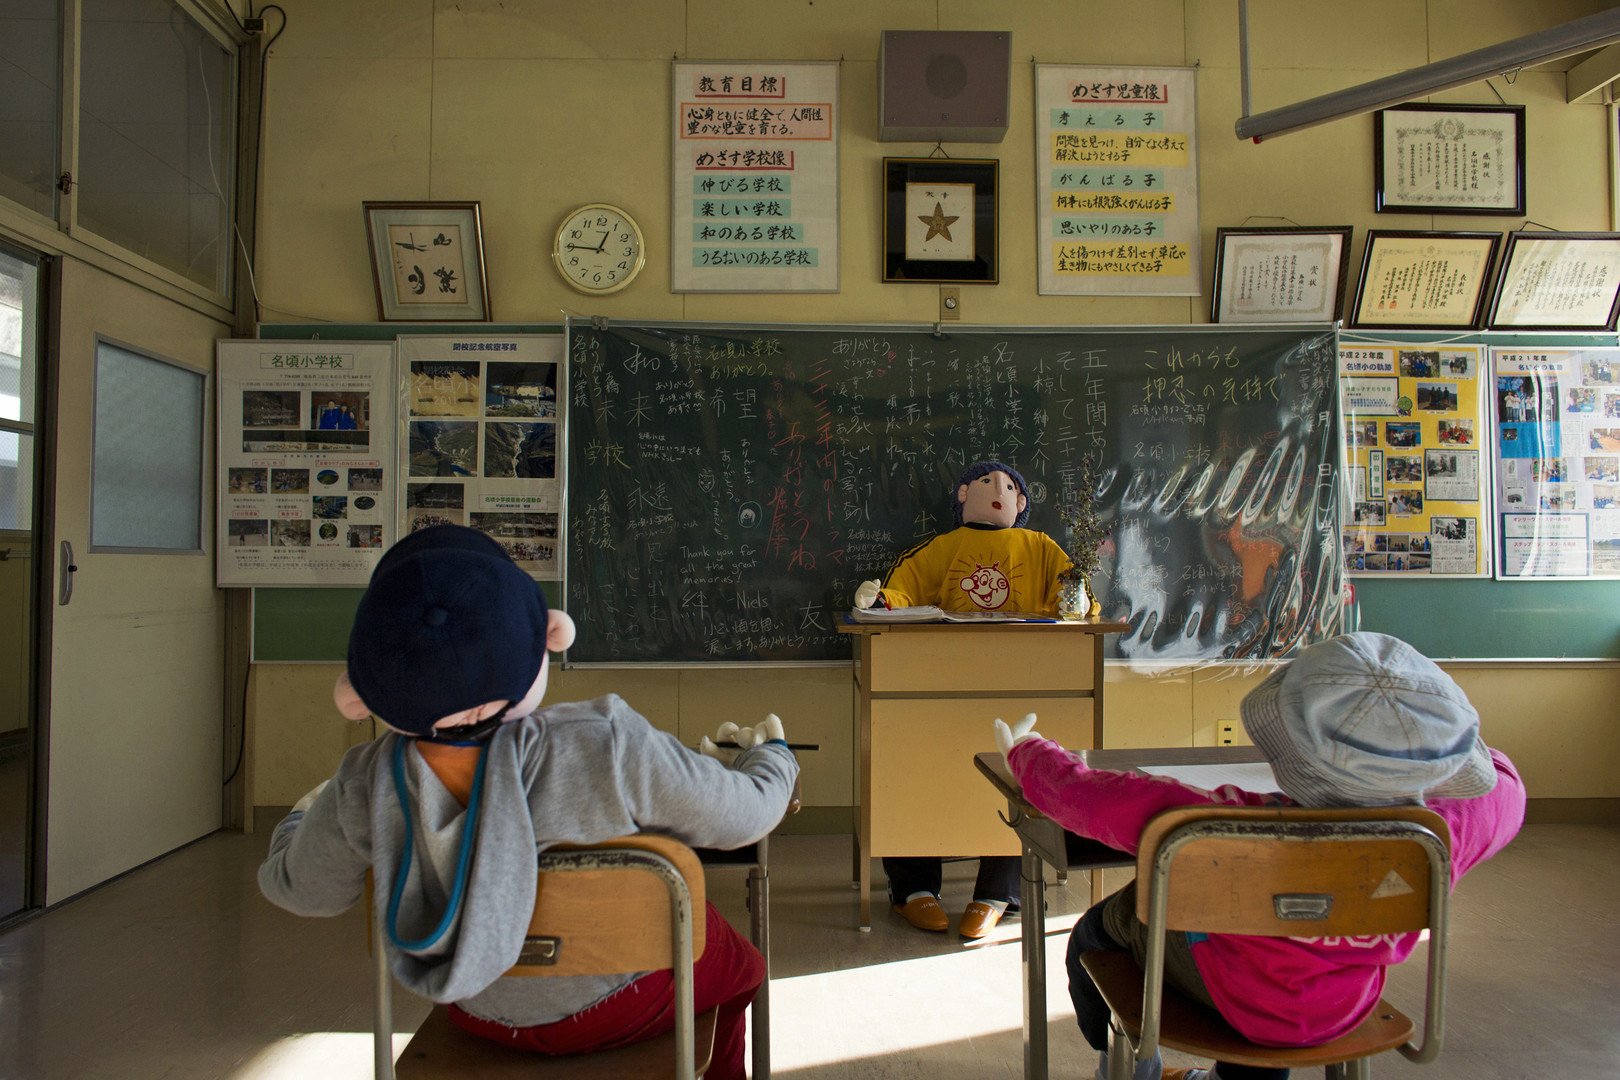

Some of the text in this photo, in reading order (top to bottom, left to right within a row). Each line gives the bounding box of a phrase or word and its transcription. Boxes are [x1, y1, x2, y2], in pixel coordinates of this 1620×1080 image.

[699, 76, 778, 93] 教育目標
[1071, 84, 1161, 99] めざす児童像
[1058, 111, 1156, 125] 考える子
[696, 150, 787, 167] めざす学校像
[1055, 149, 1131, 162] 解決しようとする子
[701, 177, 784, 192] 伸びる学校
[1060, 173, 1156, 186] がんばる子
[701, 201, 783, 217] 楽しい学校
[583, 220, 592, 228] 11
[597, 217, 608, 226] 12
[613, 222, 618, 232] 1
[1060, 221, 1156, 235] 思いやりのある子
[571, 230, 583, 240] 10
[619, 233, 630, 242] 2
[700, 225, 797, 240] 和のある学校
[622, 246, 632, 257] 3
[701, 250, 812, 265] うるおいのある学校
[570, 256, 580, 266] 8
[617, 260, 627, 270] 4
[1058, 260, 1164, 272] 生き物にもやさしくできる子
[581, 268, 589, 278] 7
[592, 272, 602, 282] 6
[606, 270, 616, 280] 5
[706, 337, 784, 361] 名頃小学校
[271, 354, 343, 369] 名頃小学校
[1143, 345, 1240, 373] これからも
[1502, 354, 1548, 362] 平成21年度
[594, 391, 655, 428] 未来
[709, 386, 758, 419] 希望
[582, 437, 632, 470] 学校
[680, 544, 758, 561] Thank you for
[680, 559, 759, 574] all the great
[800, 600, 829, 631] 友
